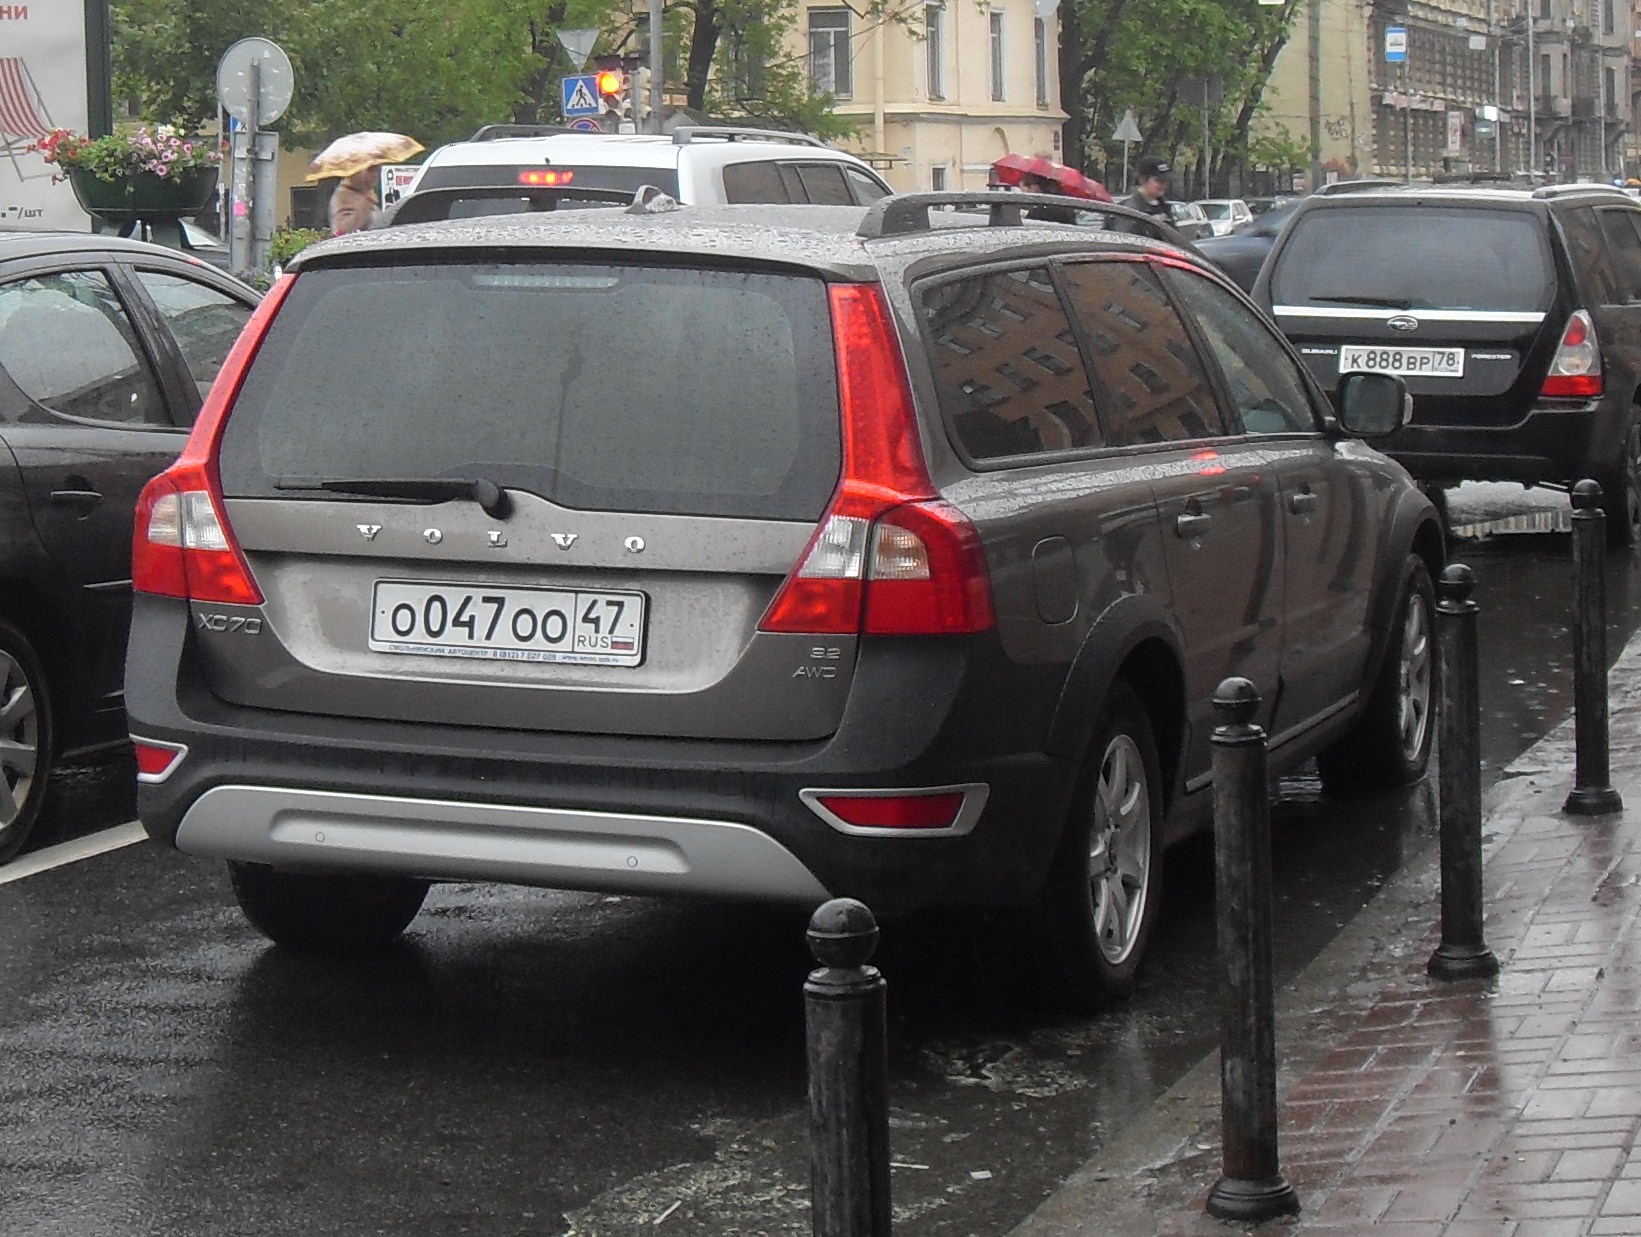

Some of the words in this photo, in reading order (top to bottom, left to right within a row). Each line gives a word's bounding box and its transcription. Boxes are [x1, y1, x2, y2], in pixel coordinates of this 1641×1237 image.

[1436, 352, 1456, 367] 78
[356, 524, 646, 553] VOLVO
[199, 613, 262, 634] XC70
[581, 599, 625, 635] 47
[577, 635, 609, 648] RUS
[792, 666, 837, 678] AWD
